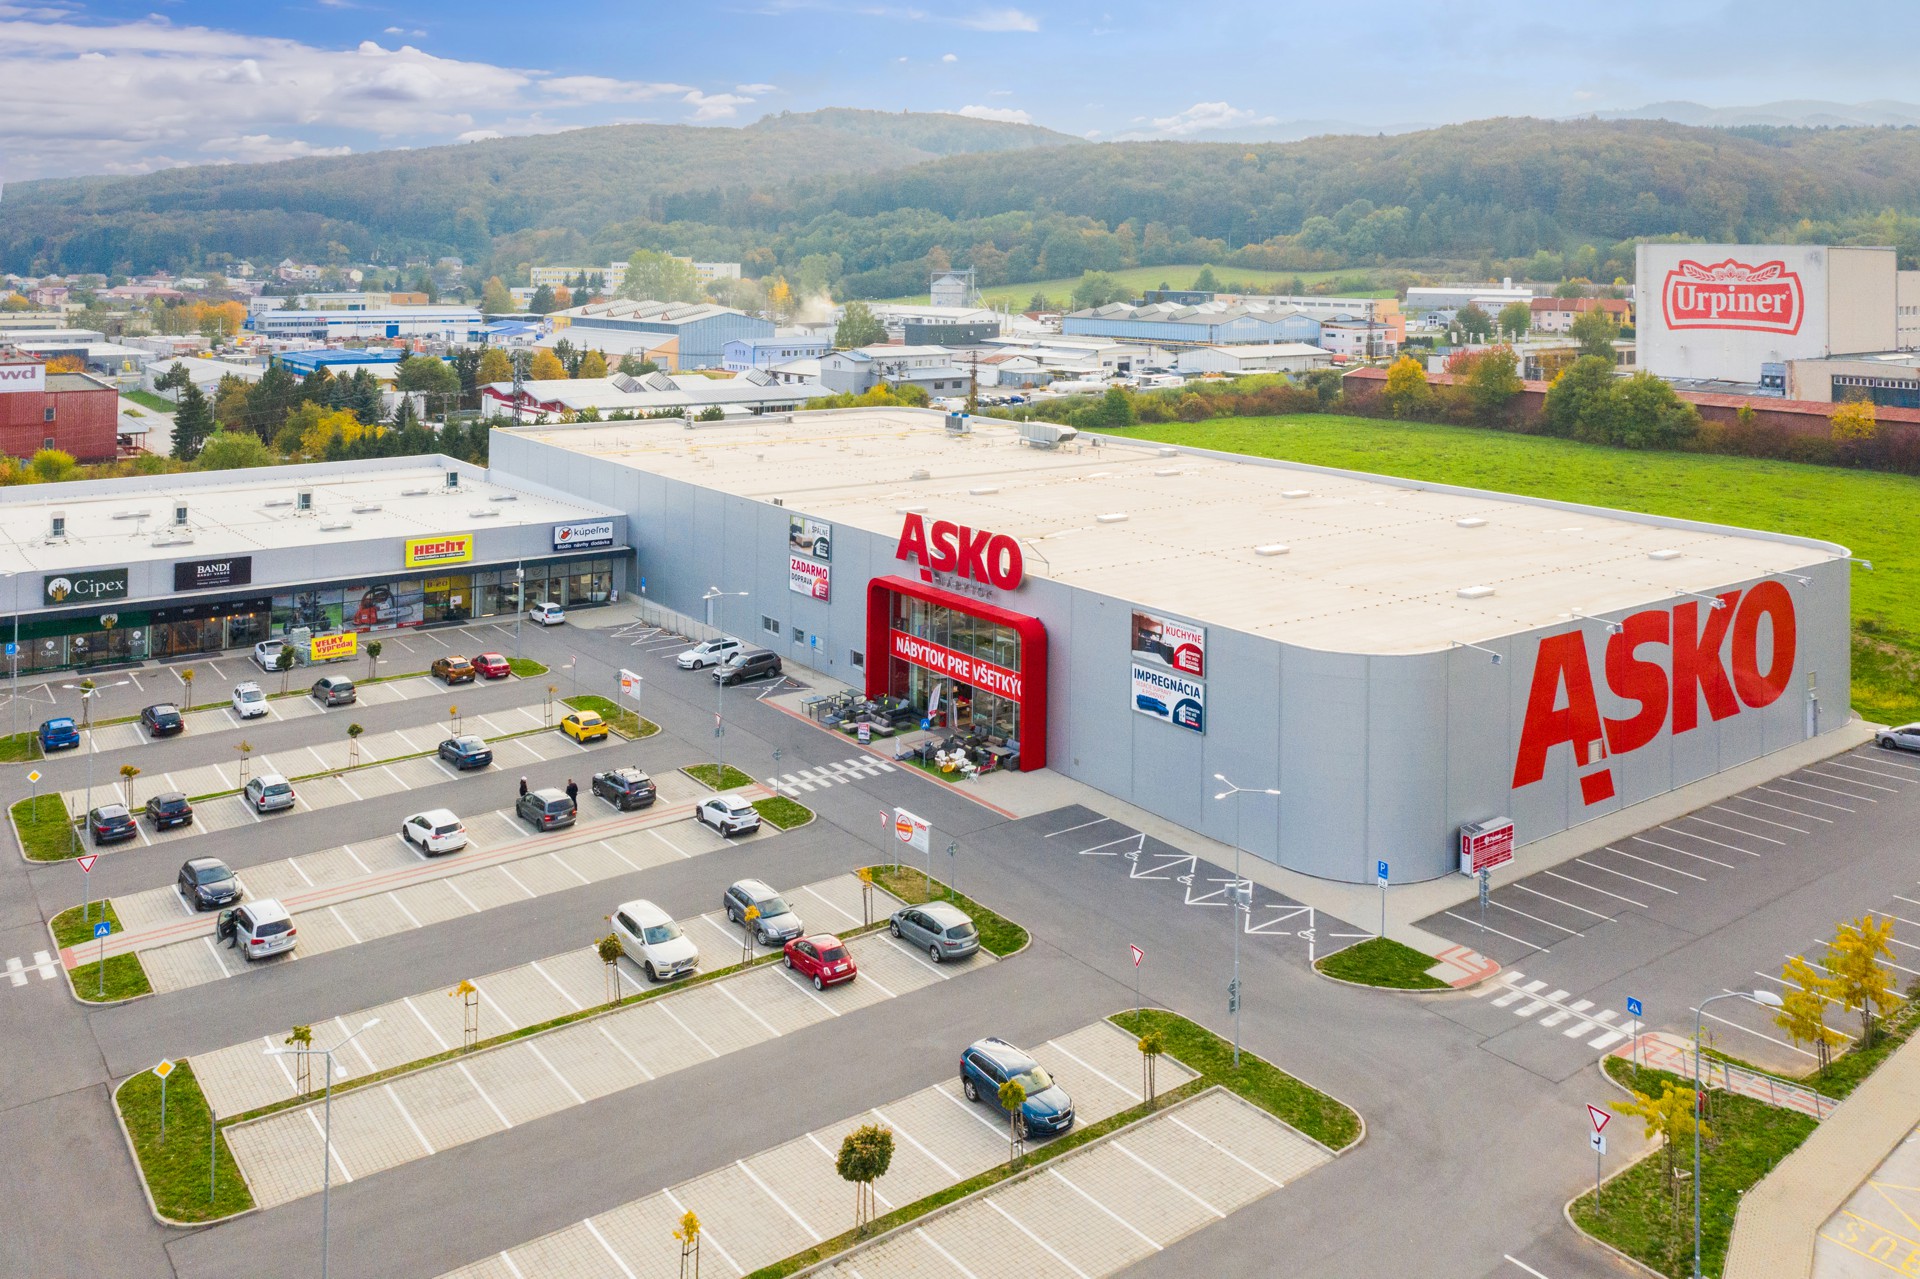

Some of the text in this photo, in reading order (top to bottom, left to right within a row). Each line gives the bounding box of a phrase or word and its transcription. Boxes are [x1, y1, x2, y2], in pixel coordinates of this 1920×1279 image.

[1676, 285, 1786, 318] Urpiner
[573, 526, 610, 537] kúpeľne
[895, 511, 1023, 591] ASKO
[197, 562, 231, 574] BANDI
[791, 558, 828, 580] ZADARMO
[74, 579, 124, 597] Cipex
[791, 572, 813, 586] DOPRAVA
[1165, 626, 1202, 645] KUCHYNE
[896, 635, 946, 669] NÁBYTOK
[948, 654, 970, 678] PRE
[1134, 667, 1201, 699] IMPREGNÁCIA
[1512, 580, 1796, 806] ASKO
[1380, 862, 1386, 872] P
